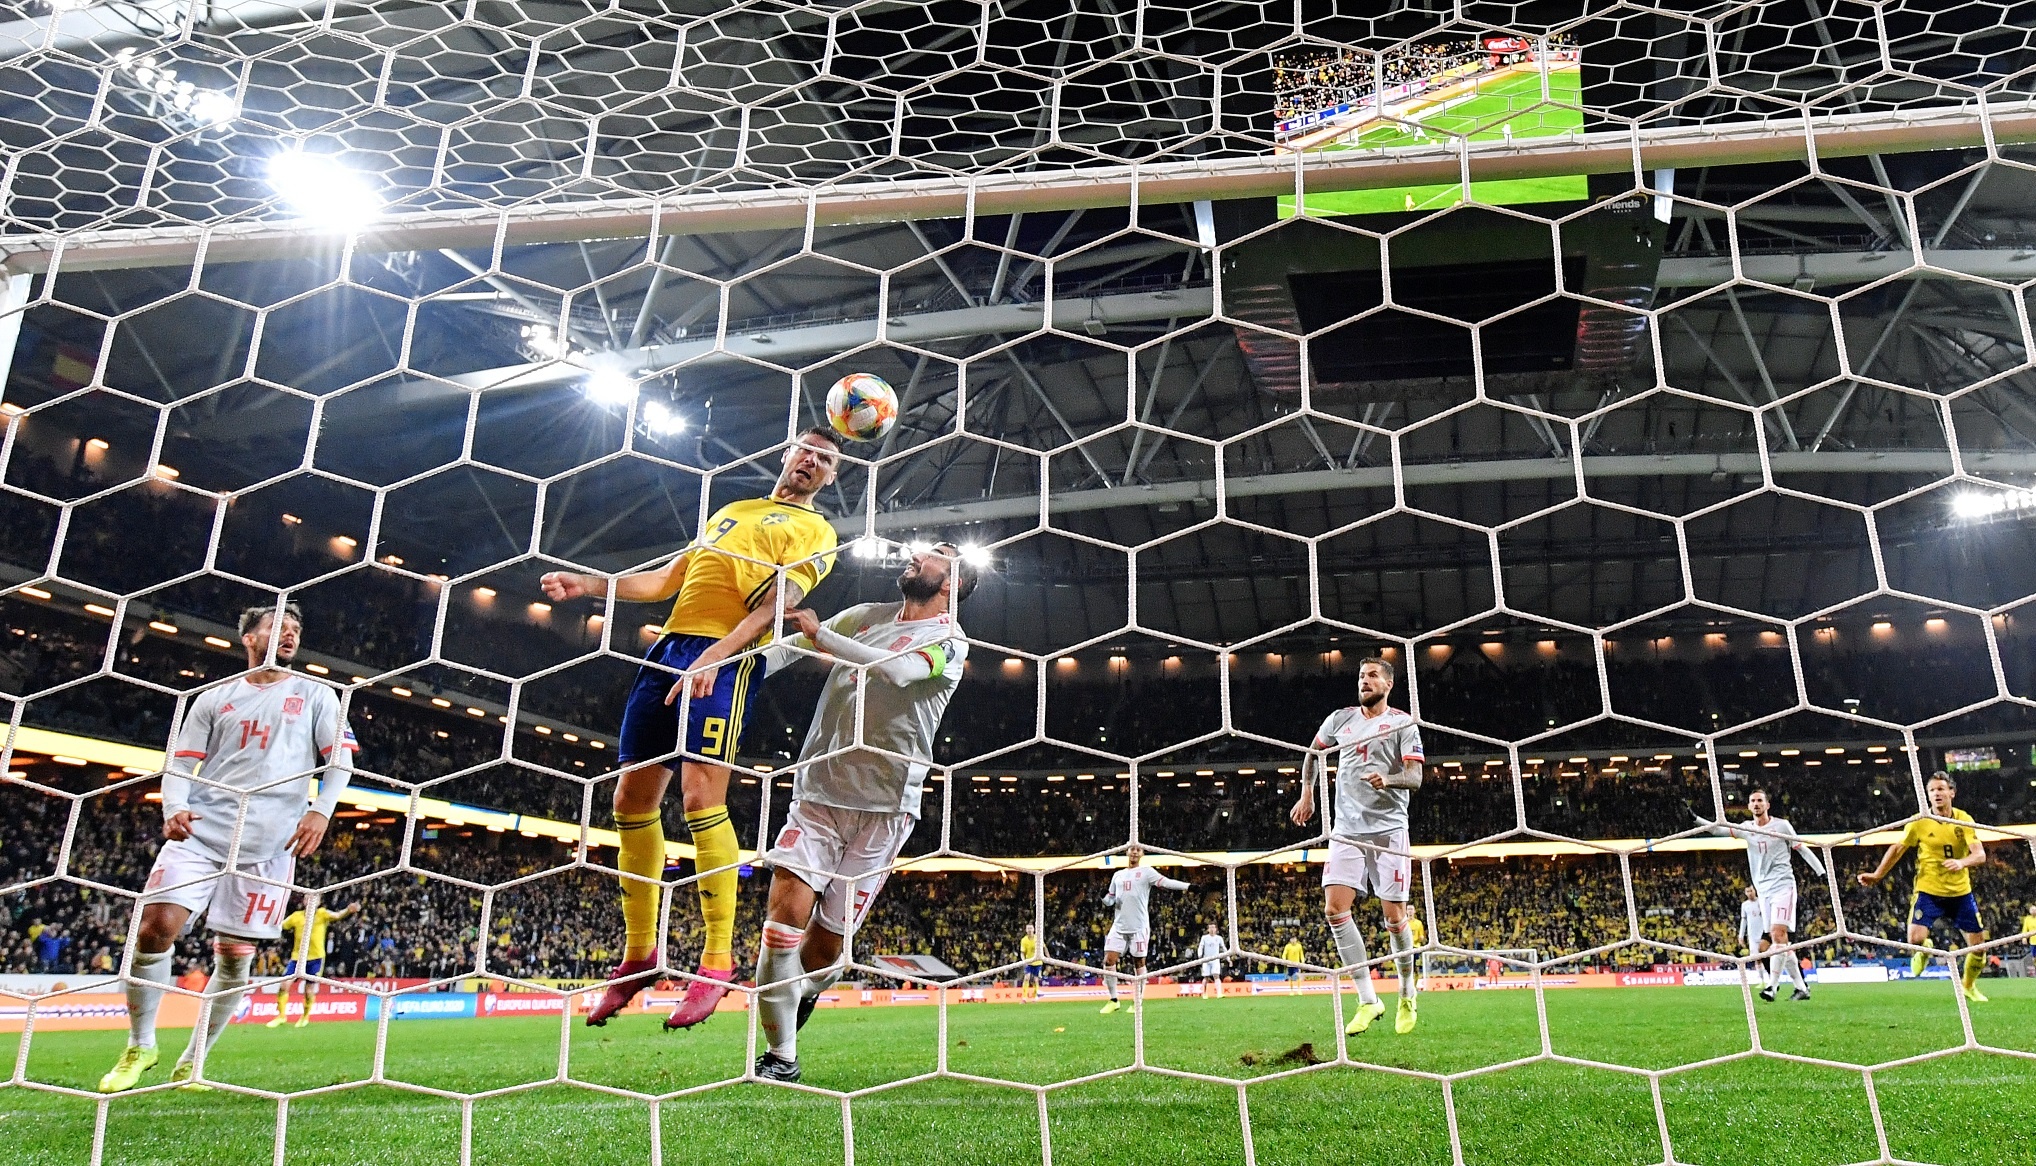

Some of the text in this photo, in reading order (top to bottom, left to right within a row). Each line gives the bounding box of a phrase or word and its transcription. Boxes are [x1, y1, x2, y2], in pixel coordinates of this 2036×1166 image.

[708, 518, 738, 544] 9
[239, 720, 270, 750] 14
[701, 717, 726, 755] 9
[1356, 742, 1368, 763] 4
[1757, 841, 1768, 854] 17
[1943, 844, 1954, 859] 8
[1122, 880, 1132, 892] 10
[1394, 869, 1404, 892] 4
[244, 892, 274, 925] 14
[1776, 906, 1788, 921] 17
[1630, 976, 1676, 986] BAUHAUS
